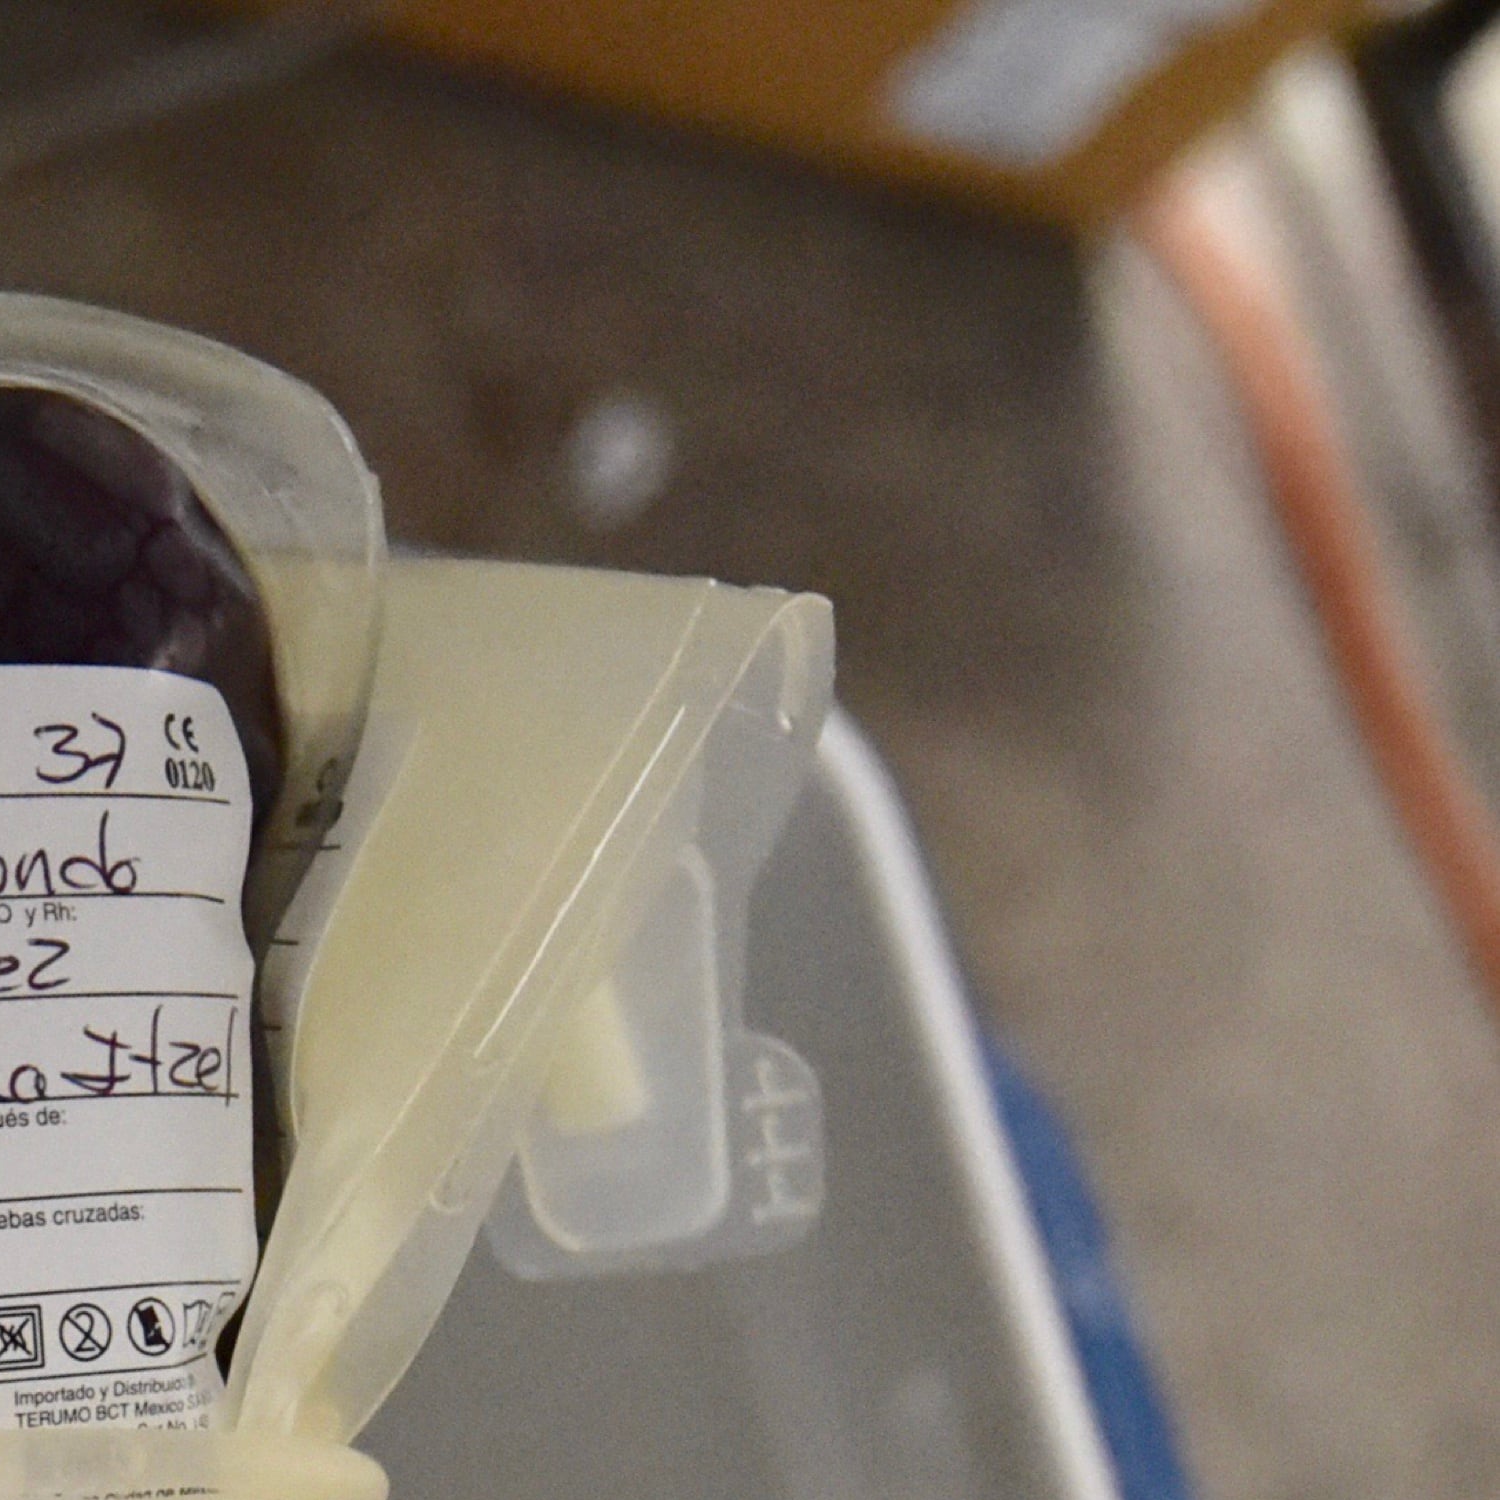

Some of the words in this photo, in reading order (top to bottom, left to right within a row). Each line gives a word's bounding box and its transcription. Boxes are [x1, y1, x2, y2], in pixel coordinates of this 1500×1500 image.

[165, 757, 215, 791] 0120
[43, 904, 77, 922] Rh:
[36, 1107, 66, 1126] de:
[52, 1204, 144, 1225] cruzadas:
[14, 1386, 95, 1408] Importado
[15, 1407, 91, 1428] TERUMO
[96, 1403, 129, 1421] BCT
